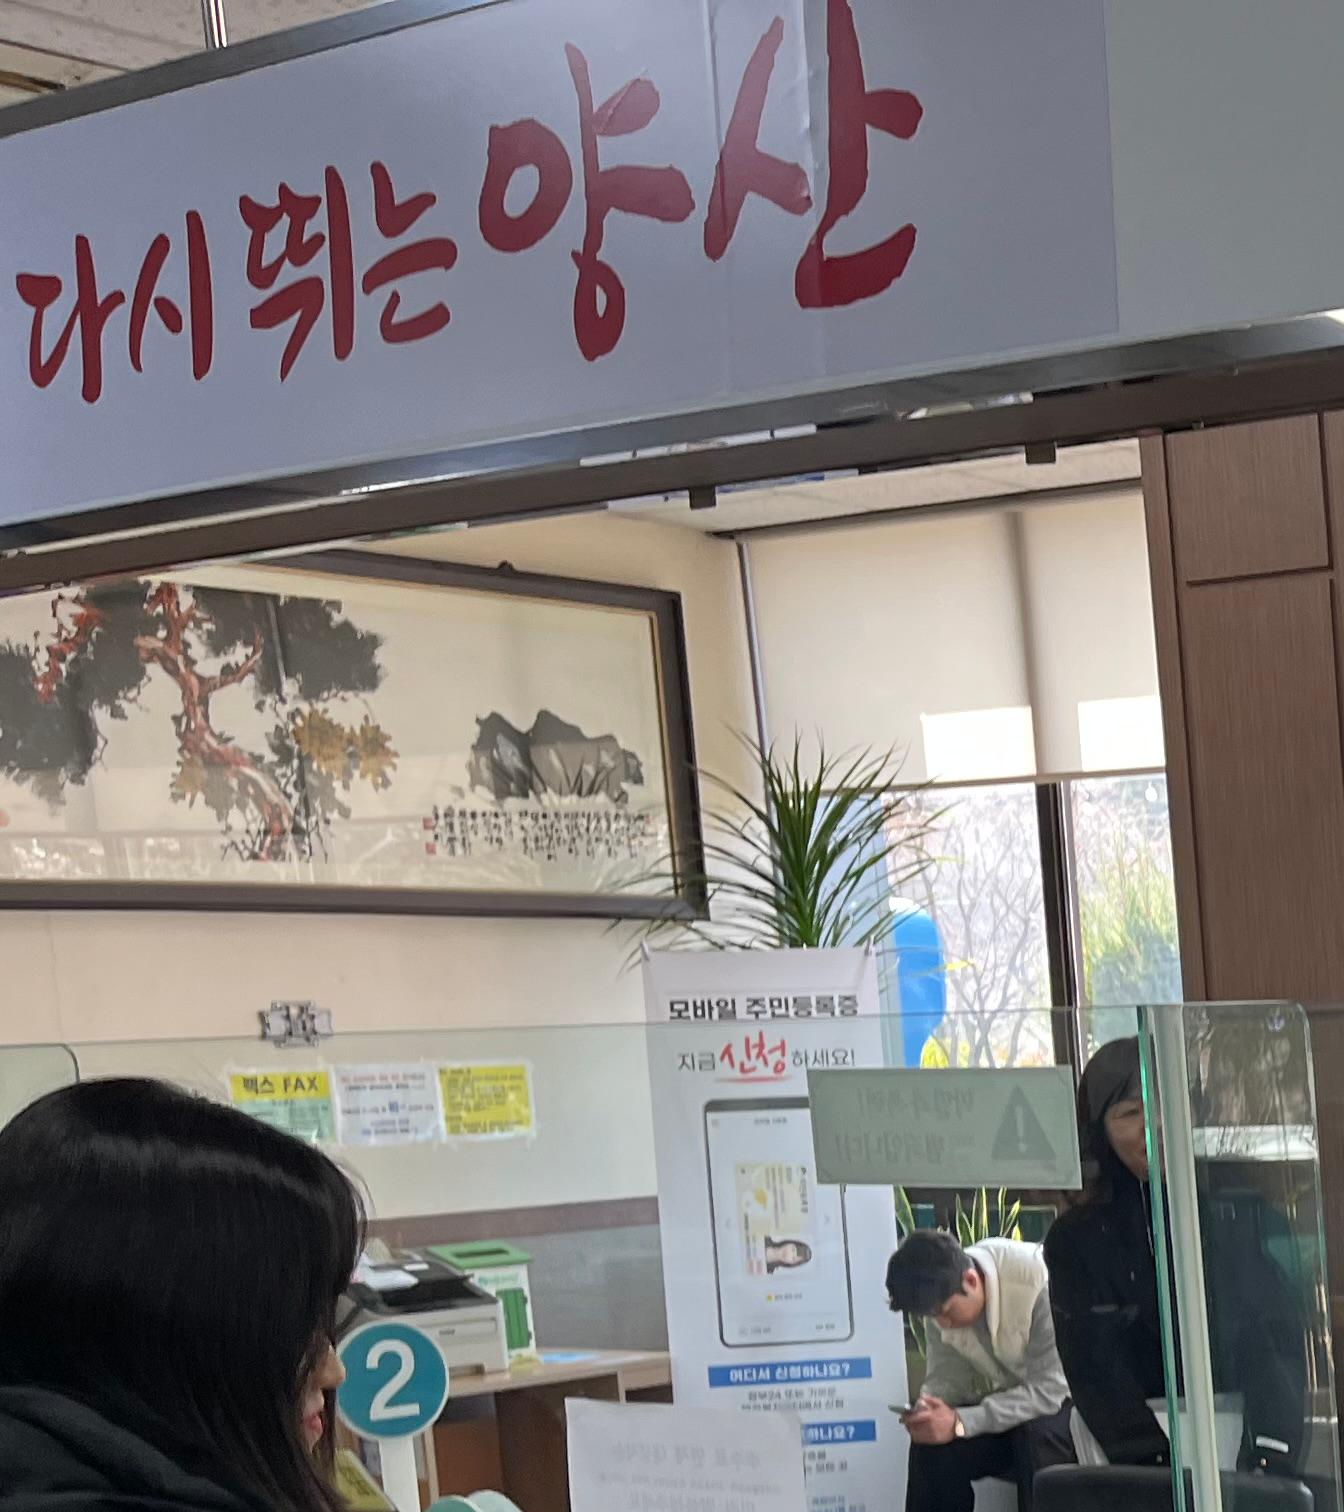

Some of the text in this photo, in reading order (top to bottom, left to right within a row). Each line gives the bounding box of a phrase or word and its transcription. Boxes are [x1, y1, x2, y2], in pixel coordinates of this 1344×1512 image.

[17, 0, 923, 402] 다시 뛰는 양산
[669, 994, 858, 1021] 모바일 주민등록증
[677, 1052, 716, 1071] 지금
[282, 1075, 319, 1093] FAX
[365, 1339, 420, 1422] 2
